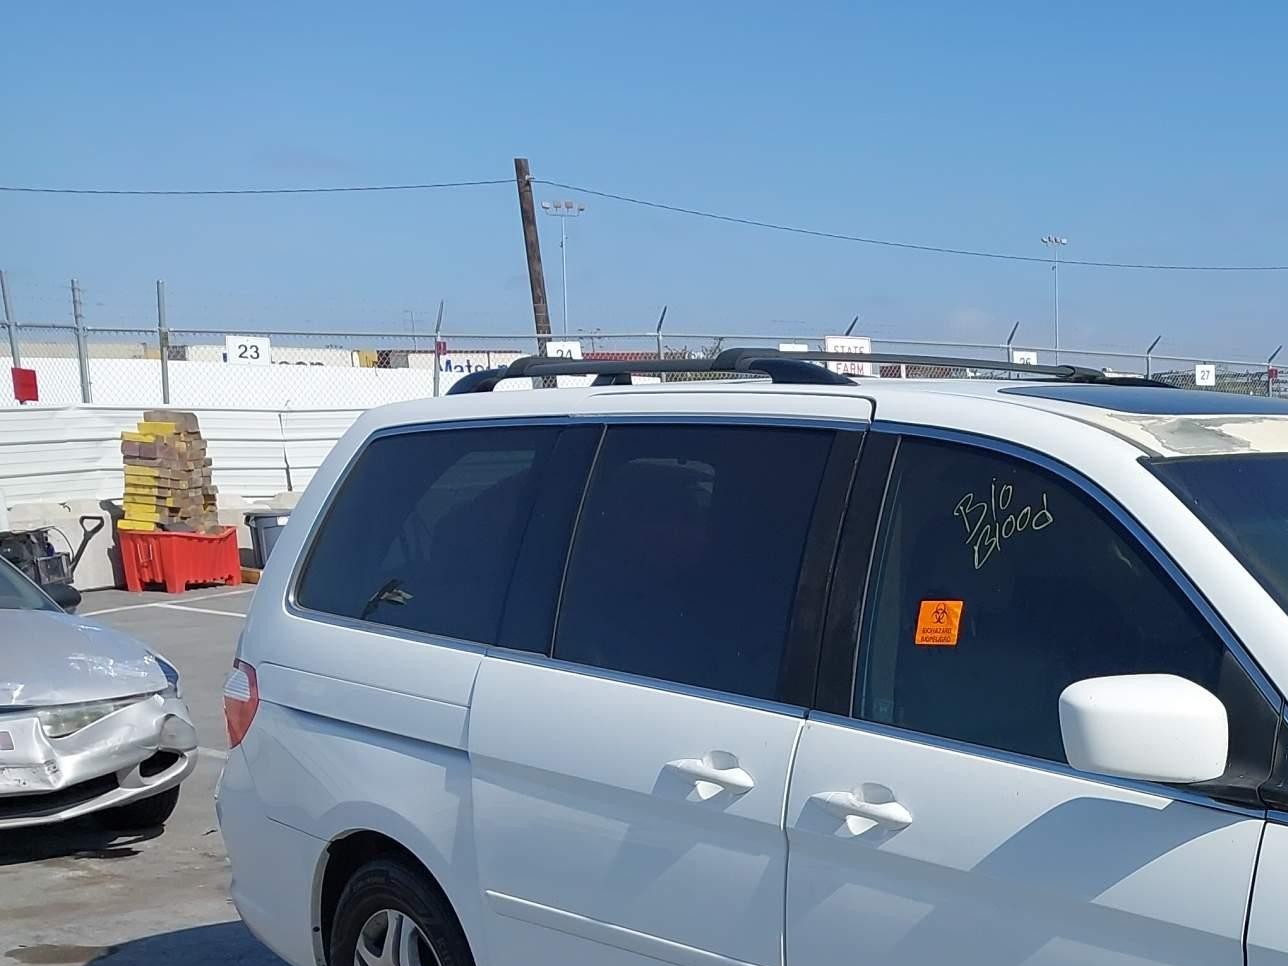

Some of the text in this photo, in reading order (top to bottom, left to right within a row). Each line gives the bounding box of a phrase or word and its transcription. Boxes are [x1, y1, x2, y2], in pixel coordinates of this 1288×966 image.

[238, 344, 260, 360] 23
[833, 344, 865, 354] STATE
[836, 362, 865, 375] FARM
[1200, 370, 1211, 381] 27
